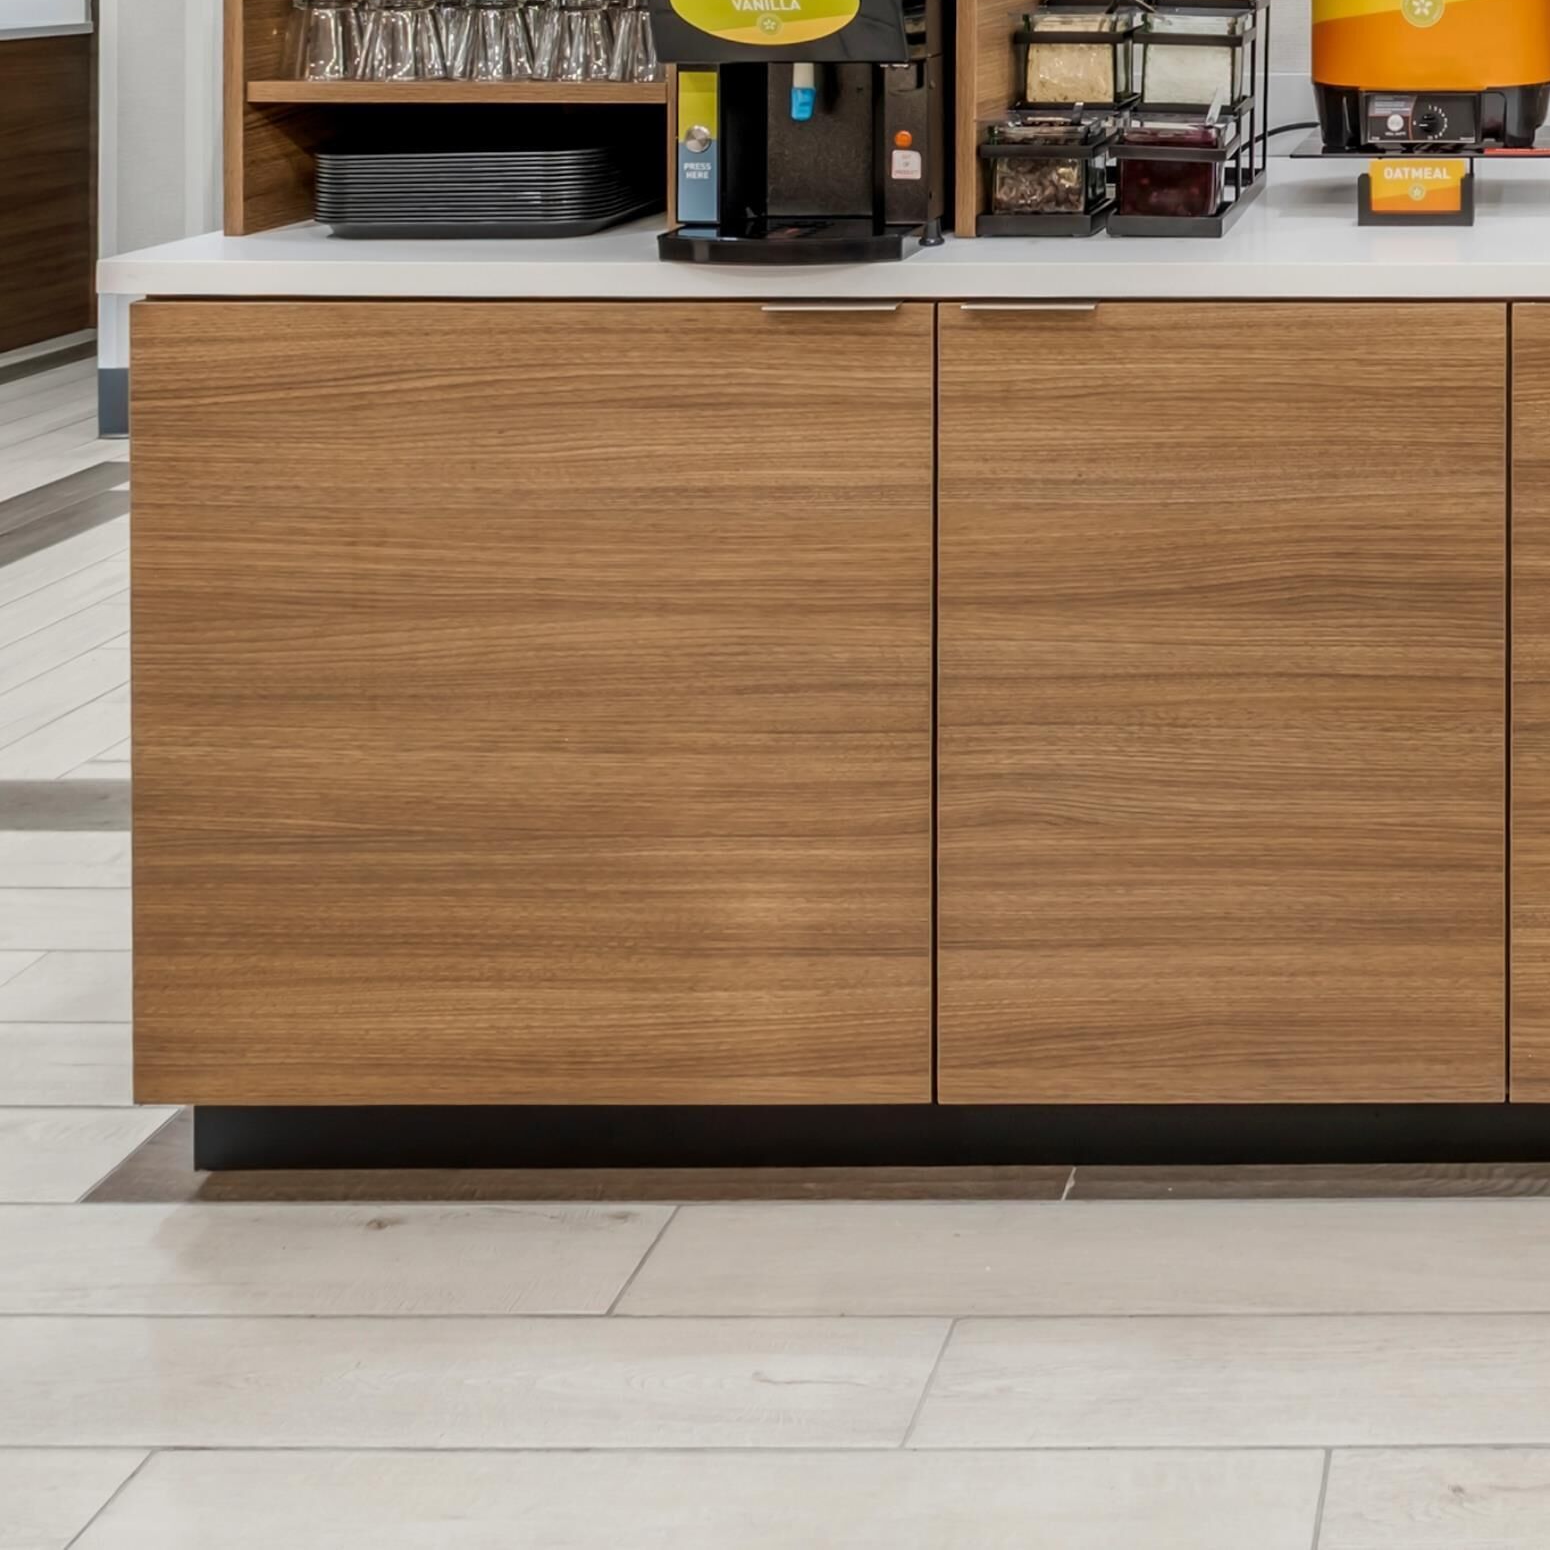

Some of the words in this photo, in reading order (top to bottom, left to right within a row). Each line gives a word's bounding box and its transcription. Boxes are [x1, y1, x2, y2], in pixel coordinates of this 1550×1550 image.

[683, 162, 712, 170] PRESS
[686, 170, 710, 179] HERE
[1384, 166, 1451, 180] OATMEAL
